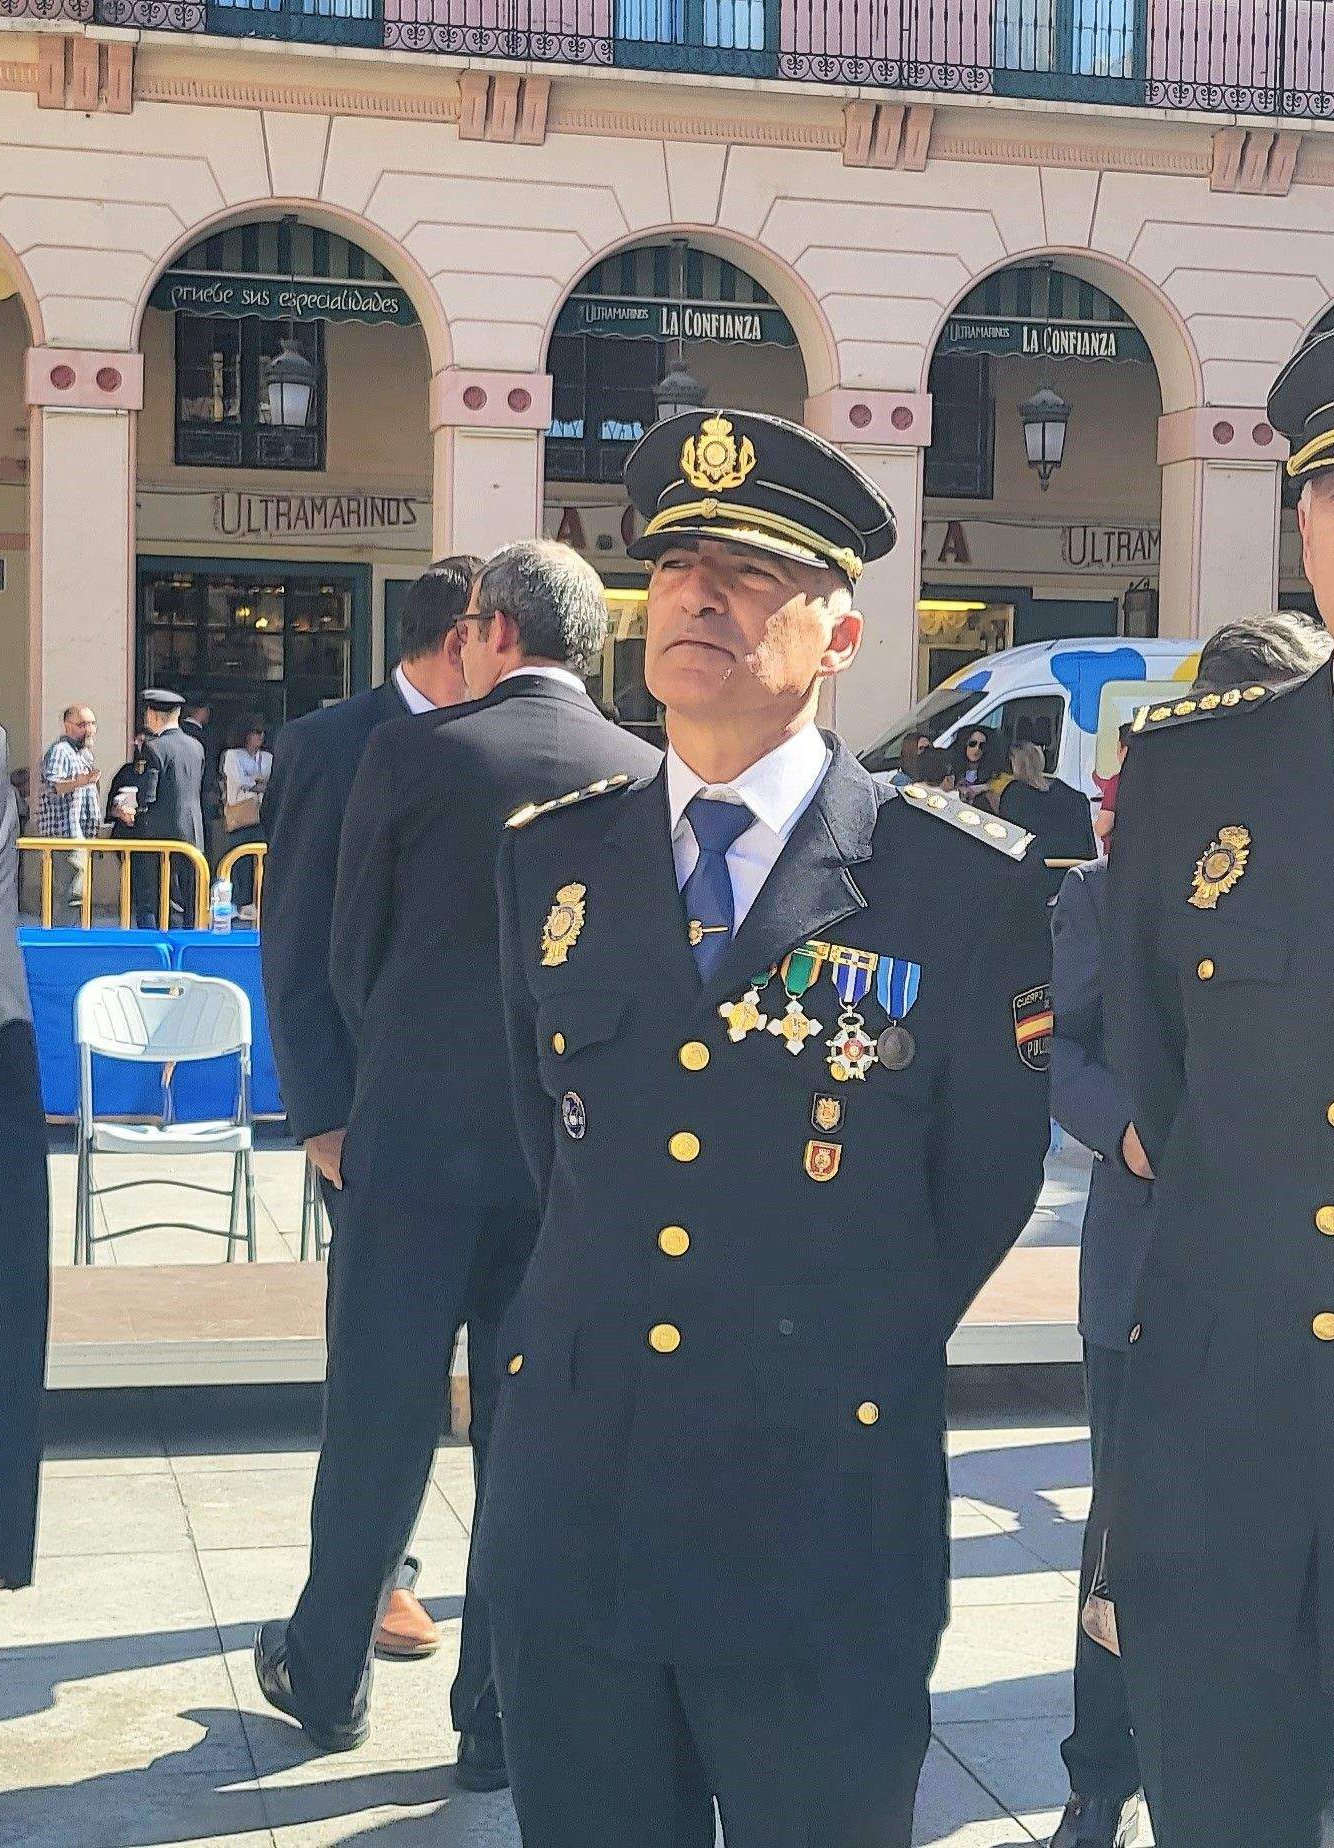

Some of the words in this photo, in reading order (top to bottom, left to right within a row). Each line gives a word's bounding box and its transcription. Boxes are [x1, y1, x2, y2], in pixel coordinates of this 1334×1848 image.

[171, 283, 234, 308] pruebe
[241, 290, 270, 306] sus
[279, 288, 400, 316] especialidades
[661, 307, 679, 336] LA
[685, 309, 762, 340] CONFIANZA
[1023, 326, 1039, 353] LA
[1044, 326, 1117, 356] CONFIANZA
[220, 491, 417, 535] ULTRAMARINOS
